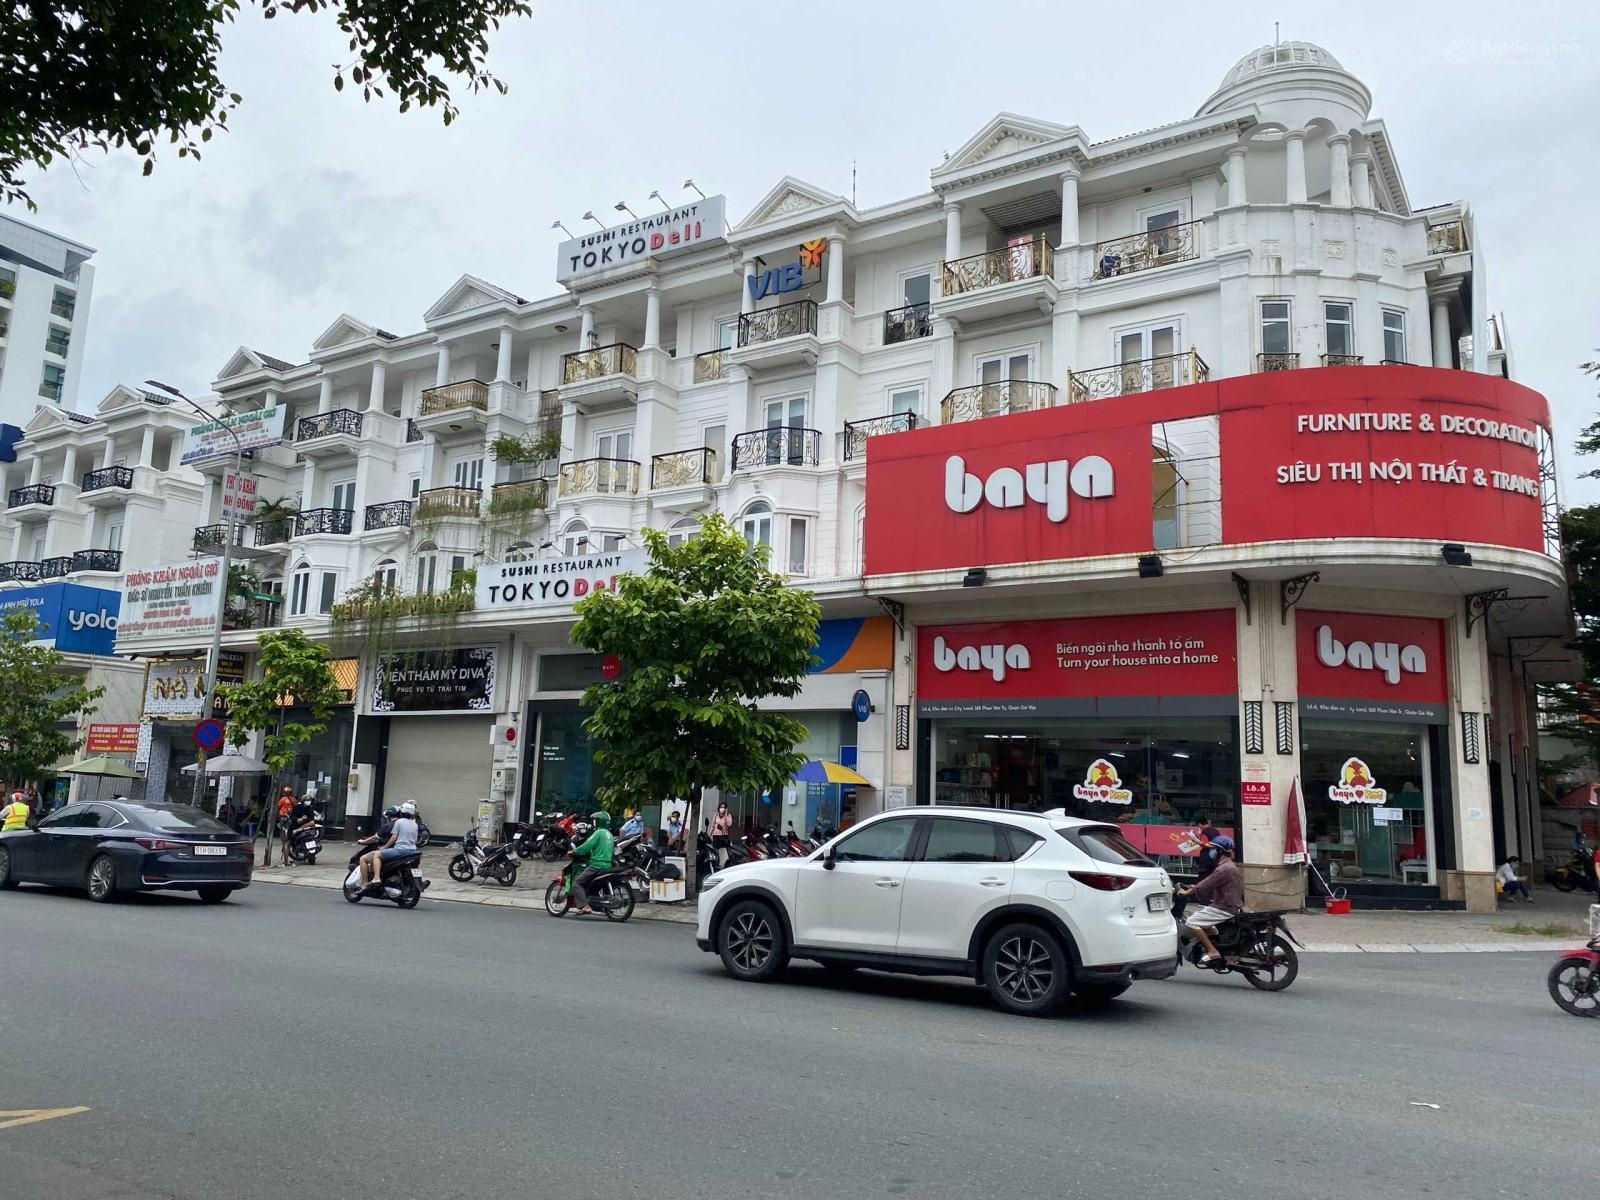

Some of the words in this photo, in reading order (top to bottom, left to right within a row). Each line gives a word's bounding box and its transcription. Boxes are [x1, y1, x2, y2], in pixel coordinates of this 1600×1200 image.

[580, 231, 616, 249] SUSHI
[620, 206, 698, 238] RESTAURANT
[747, 262, 803, 301] VIB
[1297, 412, 1413, 433] FURNITURE
[1418, 413, 1436, 432] &
[945, 455, 1115, 524] baya
[1276, 460, 1322, 484] SIÊU
[1328, 462, 1363, 485] THỊ
[1369, 458, 1413, 485] NỘI
[1418, 459, 1468, 484] THẤT
[1473, 468, 1488, 487] &
[1490, 470, 1540, 498] TRANG
[501, 564, 538, 578] SUSHI
[543, 556, 622, 574] RESTAURANT
[933, 635, 1032, 683] baya
[1056, 642, 1079, 655] Biến
[1056, 656, 1082, 669] Turn
[1084, 657, 1111, 671] your
[1112, 653, 1148, 667] house
[1149, 653, 1172, 666] into
[1172, 656, 1181, 665] a
[1182, 651, 1219, 664] home
[1316, 624, 1427, 685] baya
[460, 667, 486, 680] DIVA
[1246, 784, 1266, 792] L6.6
